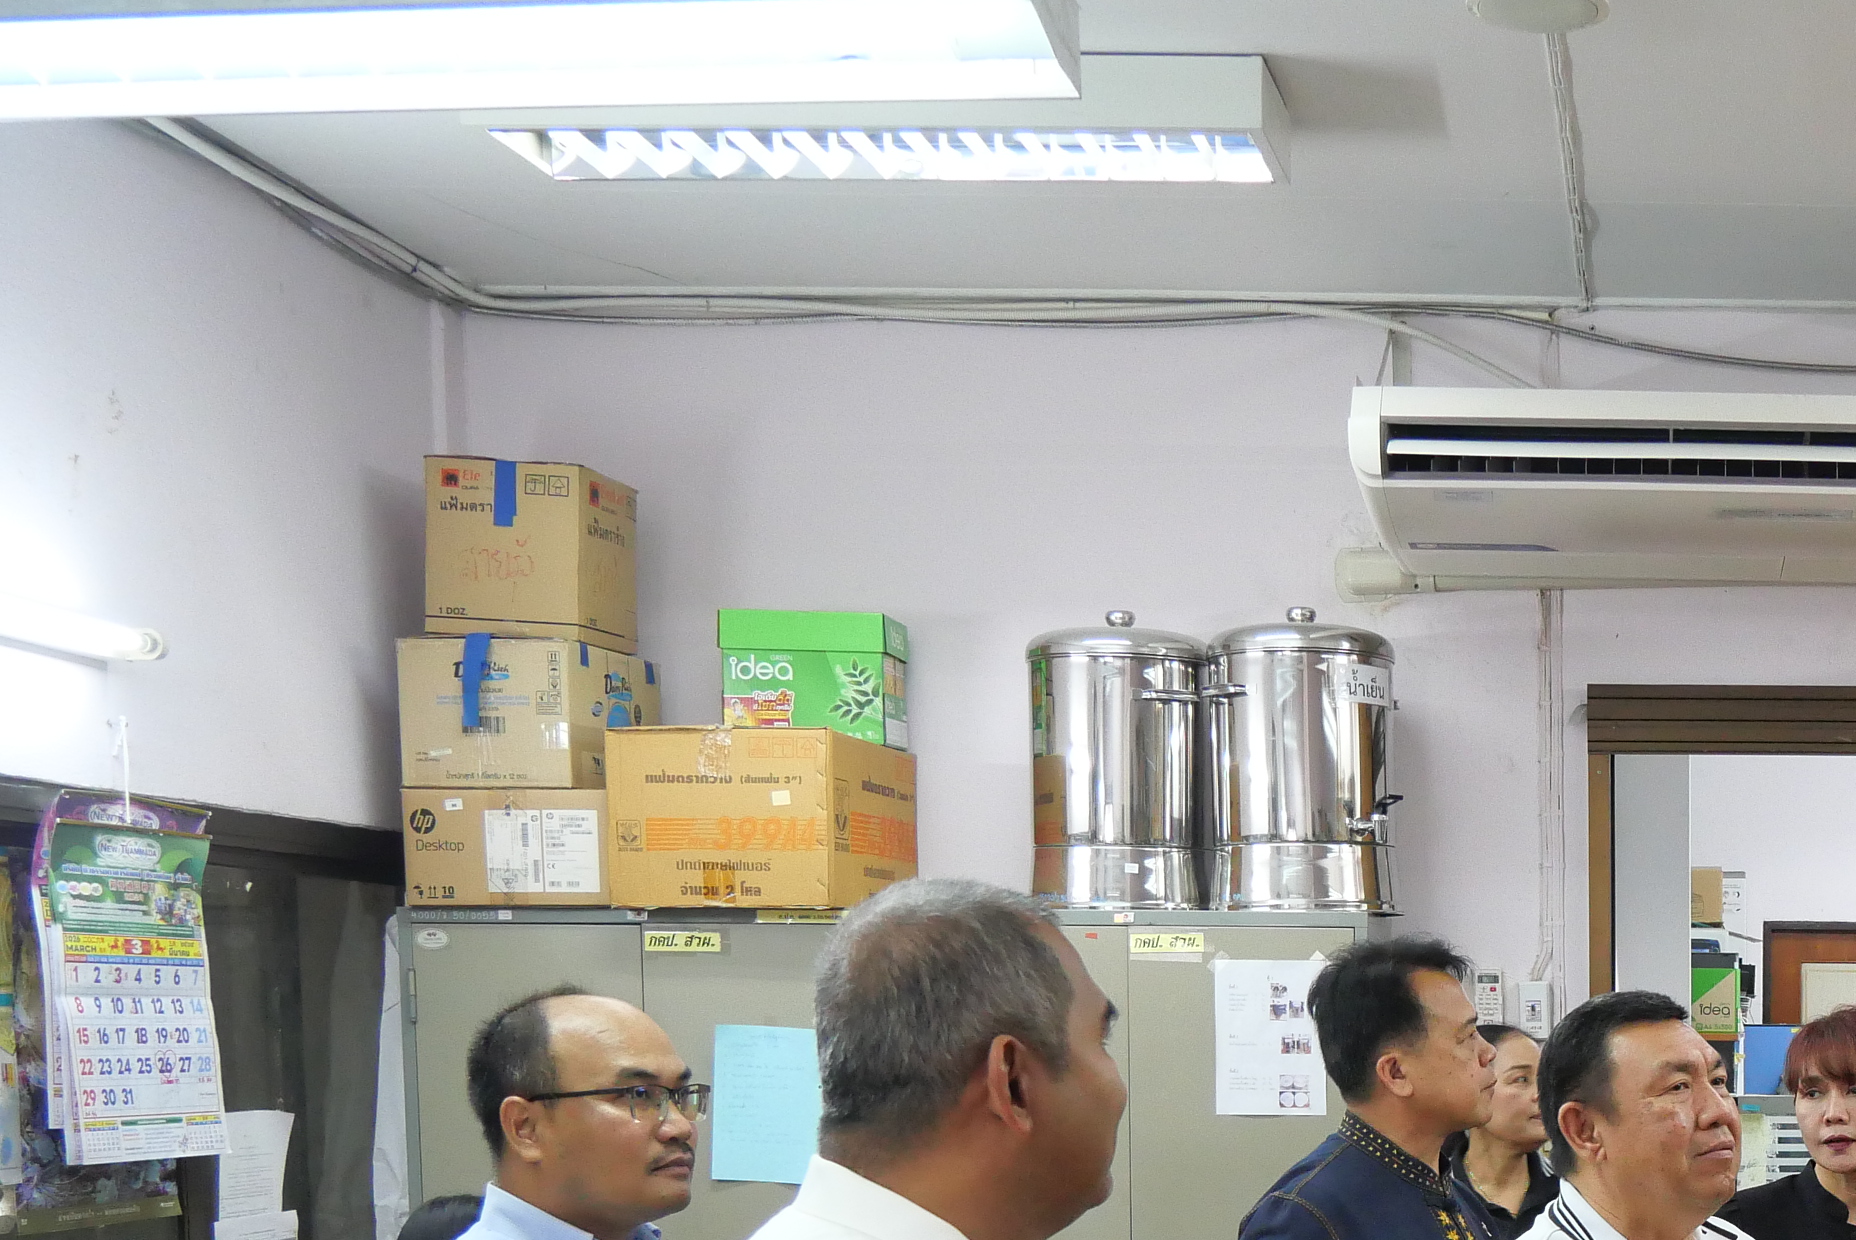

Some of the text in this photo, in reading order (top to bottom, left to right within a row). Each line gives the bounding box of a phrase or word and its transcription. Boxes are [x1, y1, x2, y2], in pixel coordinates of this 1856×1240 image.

[440, 496, 492, 513] แฟ้มตรา
[446, 606, 468, 616] DOZ.
[730, 654, 793, 680] idea
[1347, 669, 1385, 700] น้ำเย็น
[410, 808, 436, 834] hp
[416, 839, 464, 853] Desktop
[740, 881, 761, 896] โหล
[66, 944, 97, 953] MARCH
[131, 939, 142, 954] 3
[73, 966, 198, 985] 1 2 3 4 5 6 7
[75, 997, 203, 1014] 8 9 10 11 12 13 14
[1699, 1003, 1730, 1016] idea
[77, 1028, 208, 1045] 15 16 17 18 19 20 21
[80, 1056, 211, 1075] 22 23 24 25 26 27 28
[83, 1089, 134, 1106] 29 30 31
